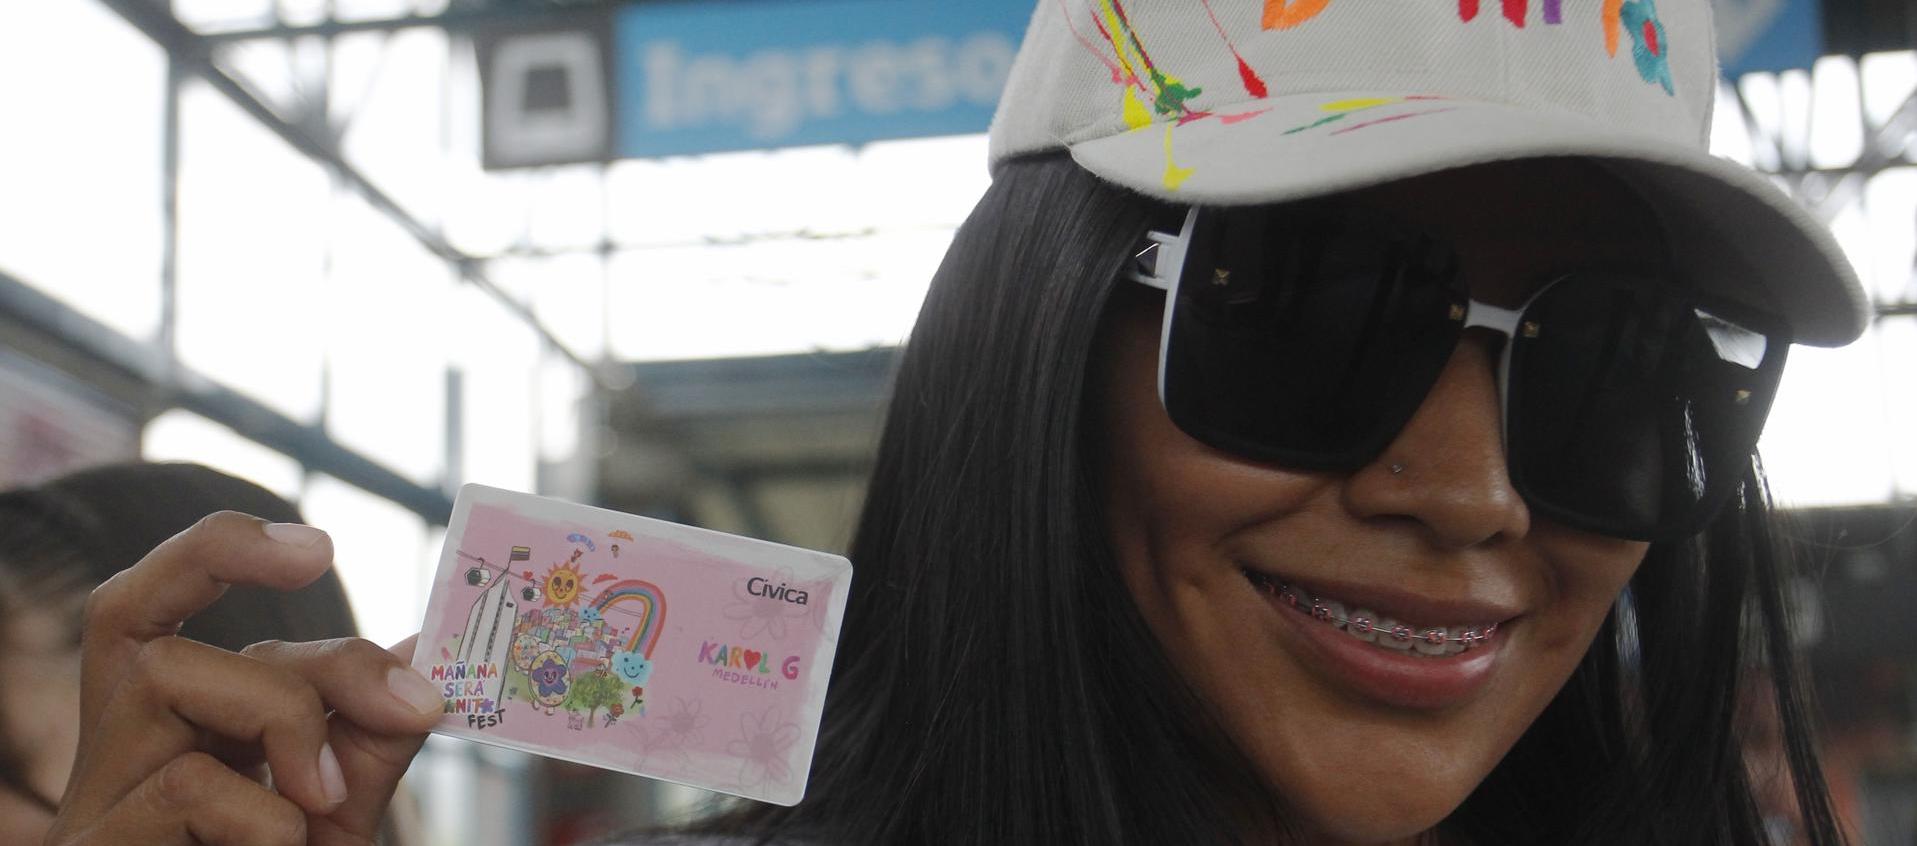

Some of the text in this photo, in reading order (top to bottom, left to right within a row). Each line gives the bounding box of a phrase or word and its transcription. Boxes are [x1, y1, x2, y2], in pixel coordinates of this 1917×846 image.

[643, 36, 1013, 138] Ingreso
[431, 661, 498, 681] MAÑANA
[781, 655, 801, 680] G
[443, 680, 486, 698] SERÁ
[467, 708, 506, 730] FEST
